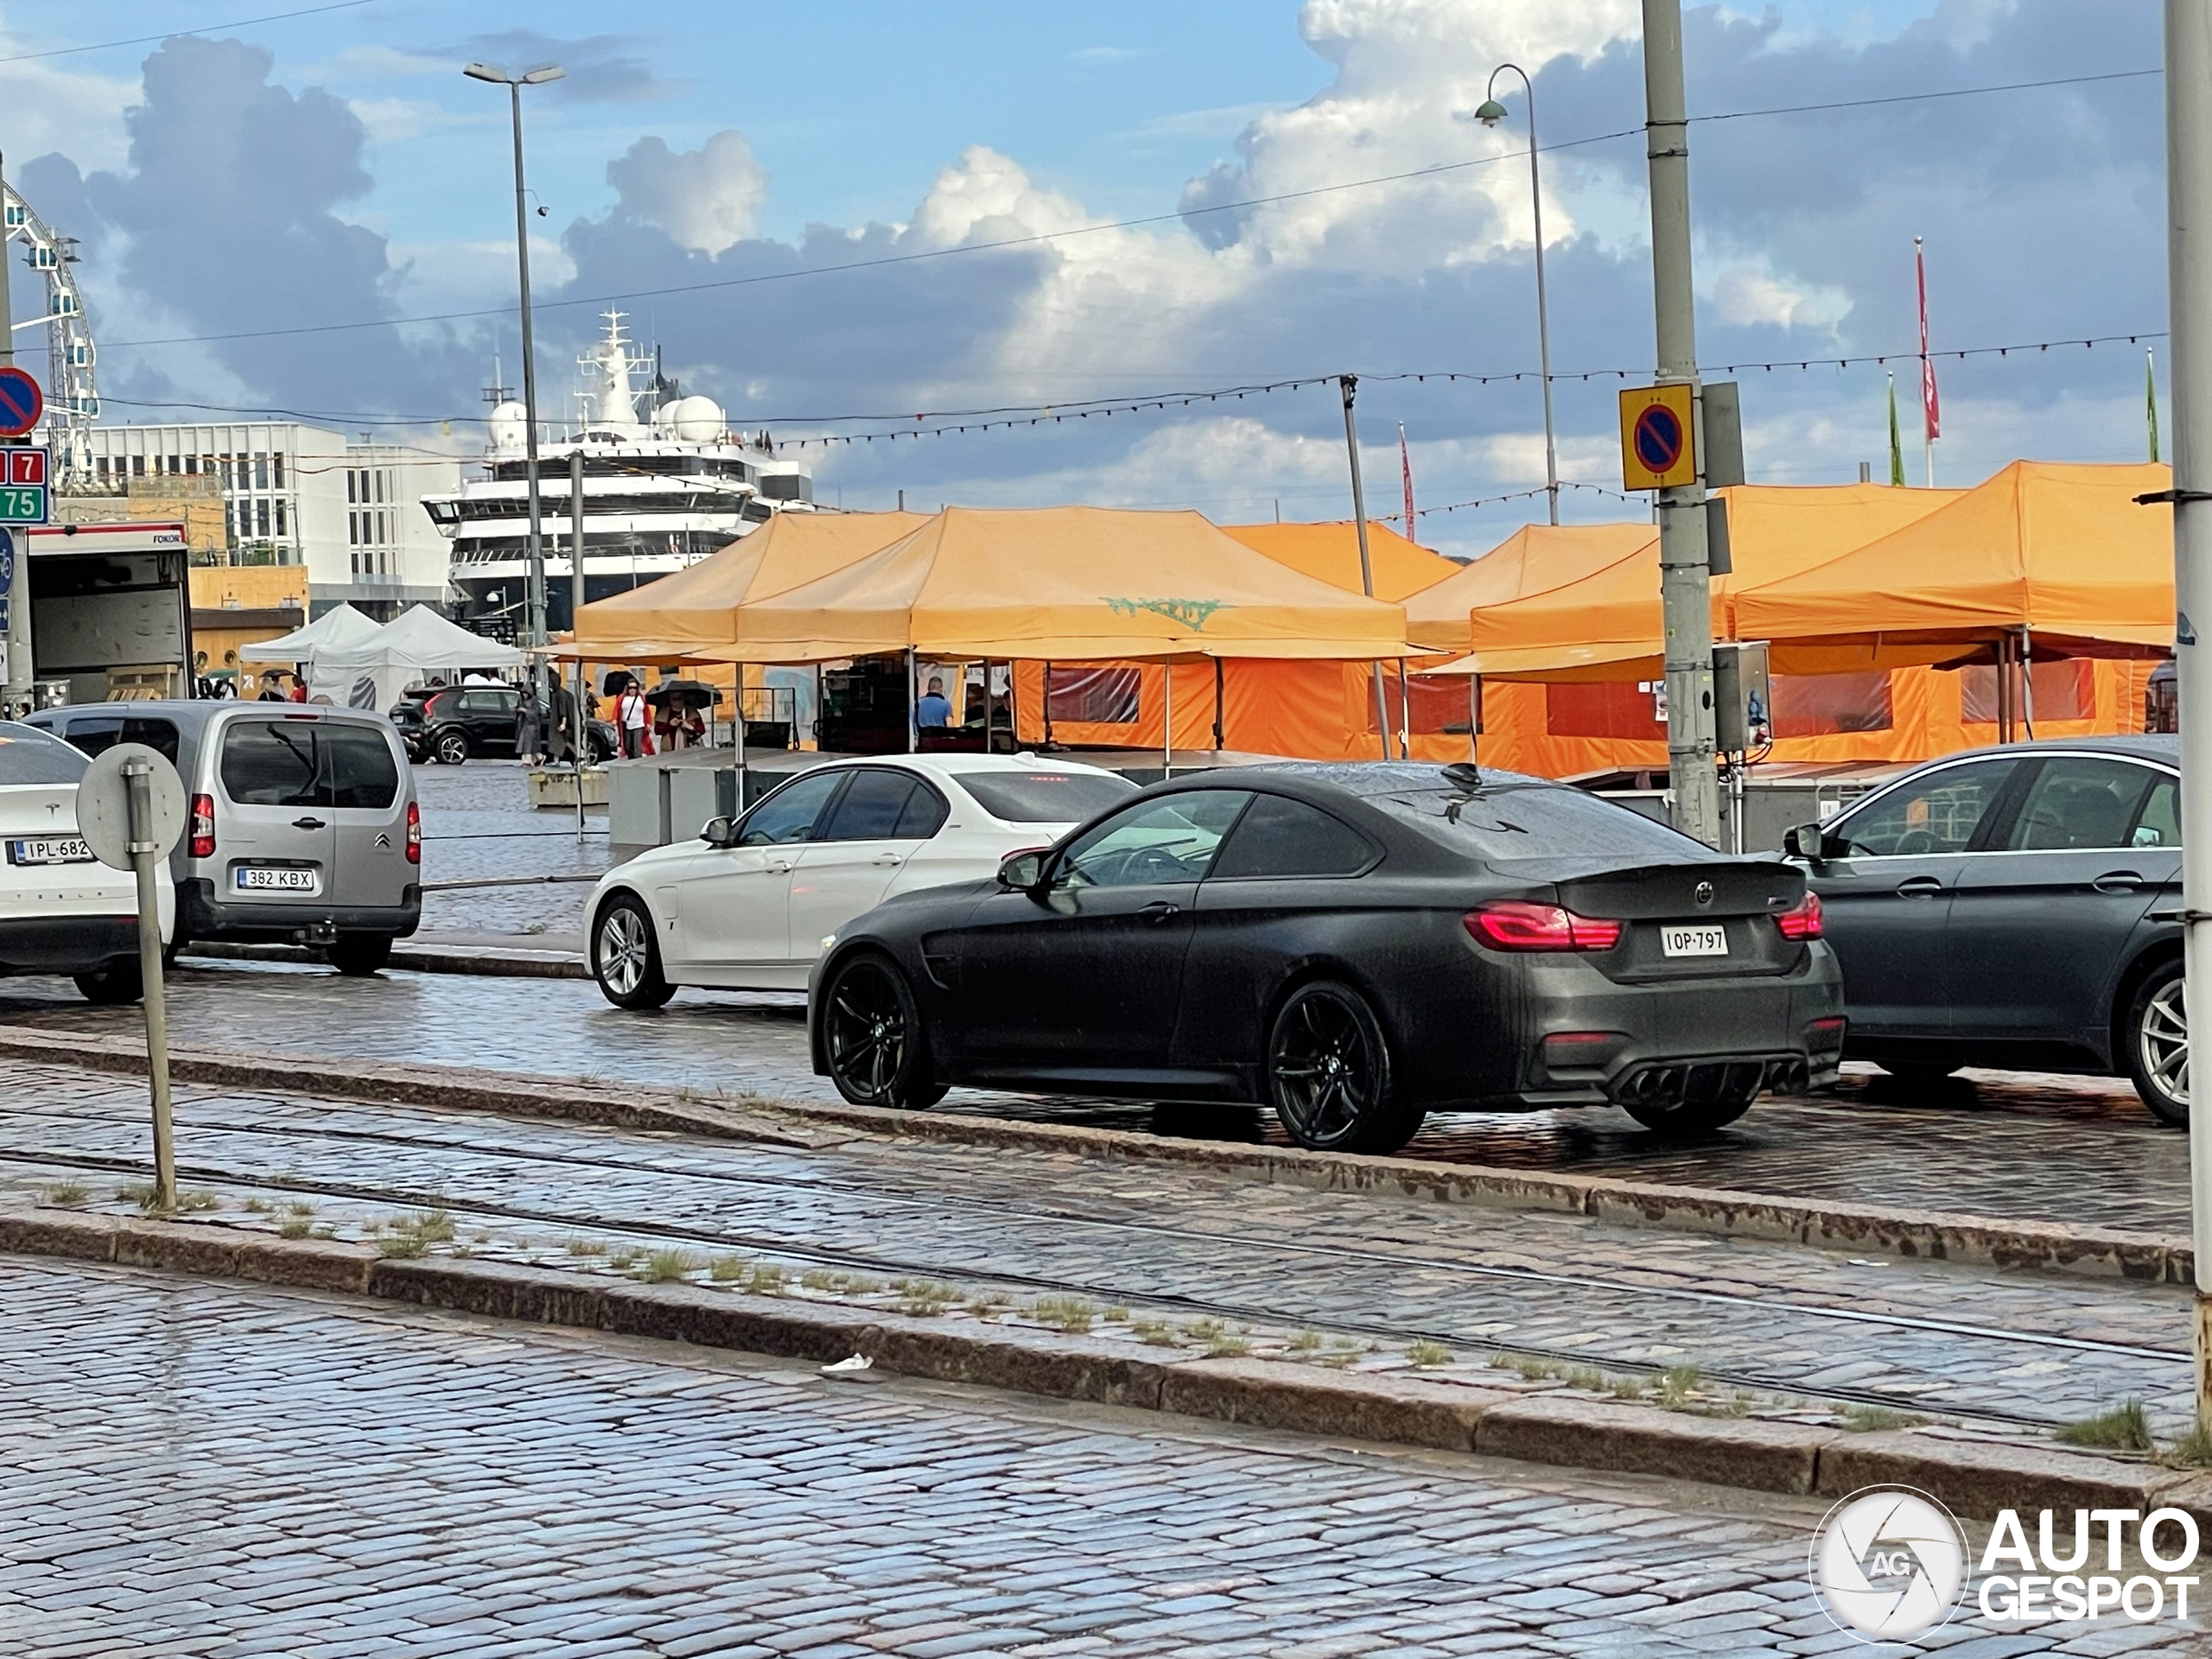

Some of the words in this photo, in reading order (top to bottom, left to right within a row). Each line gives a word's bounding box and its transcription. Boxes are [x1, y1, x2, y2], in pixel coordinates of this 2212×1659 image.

[22, 456, 34, 480] 7
[5, 492, 35, 516] 75
[153, 534, 180, 543] FOKOR
[29, 841, 88, 858] IPL-682
[250, 871, 273, 885] 382
[279, 872, 309, 886] KBX
